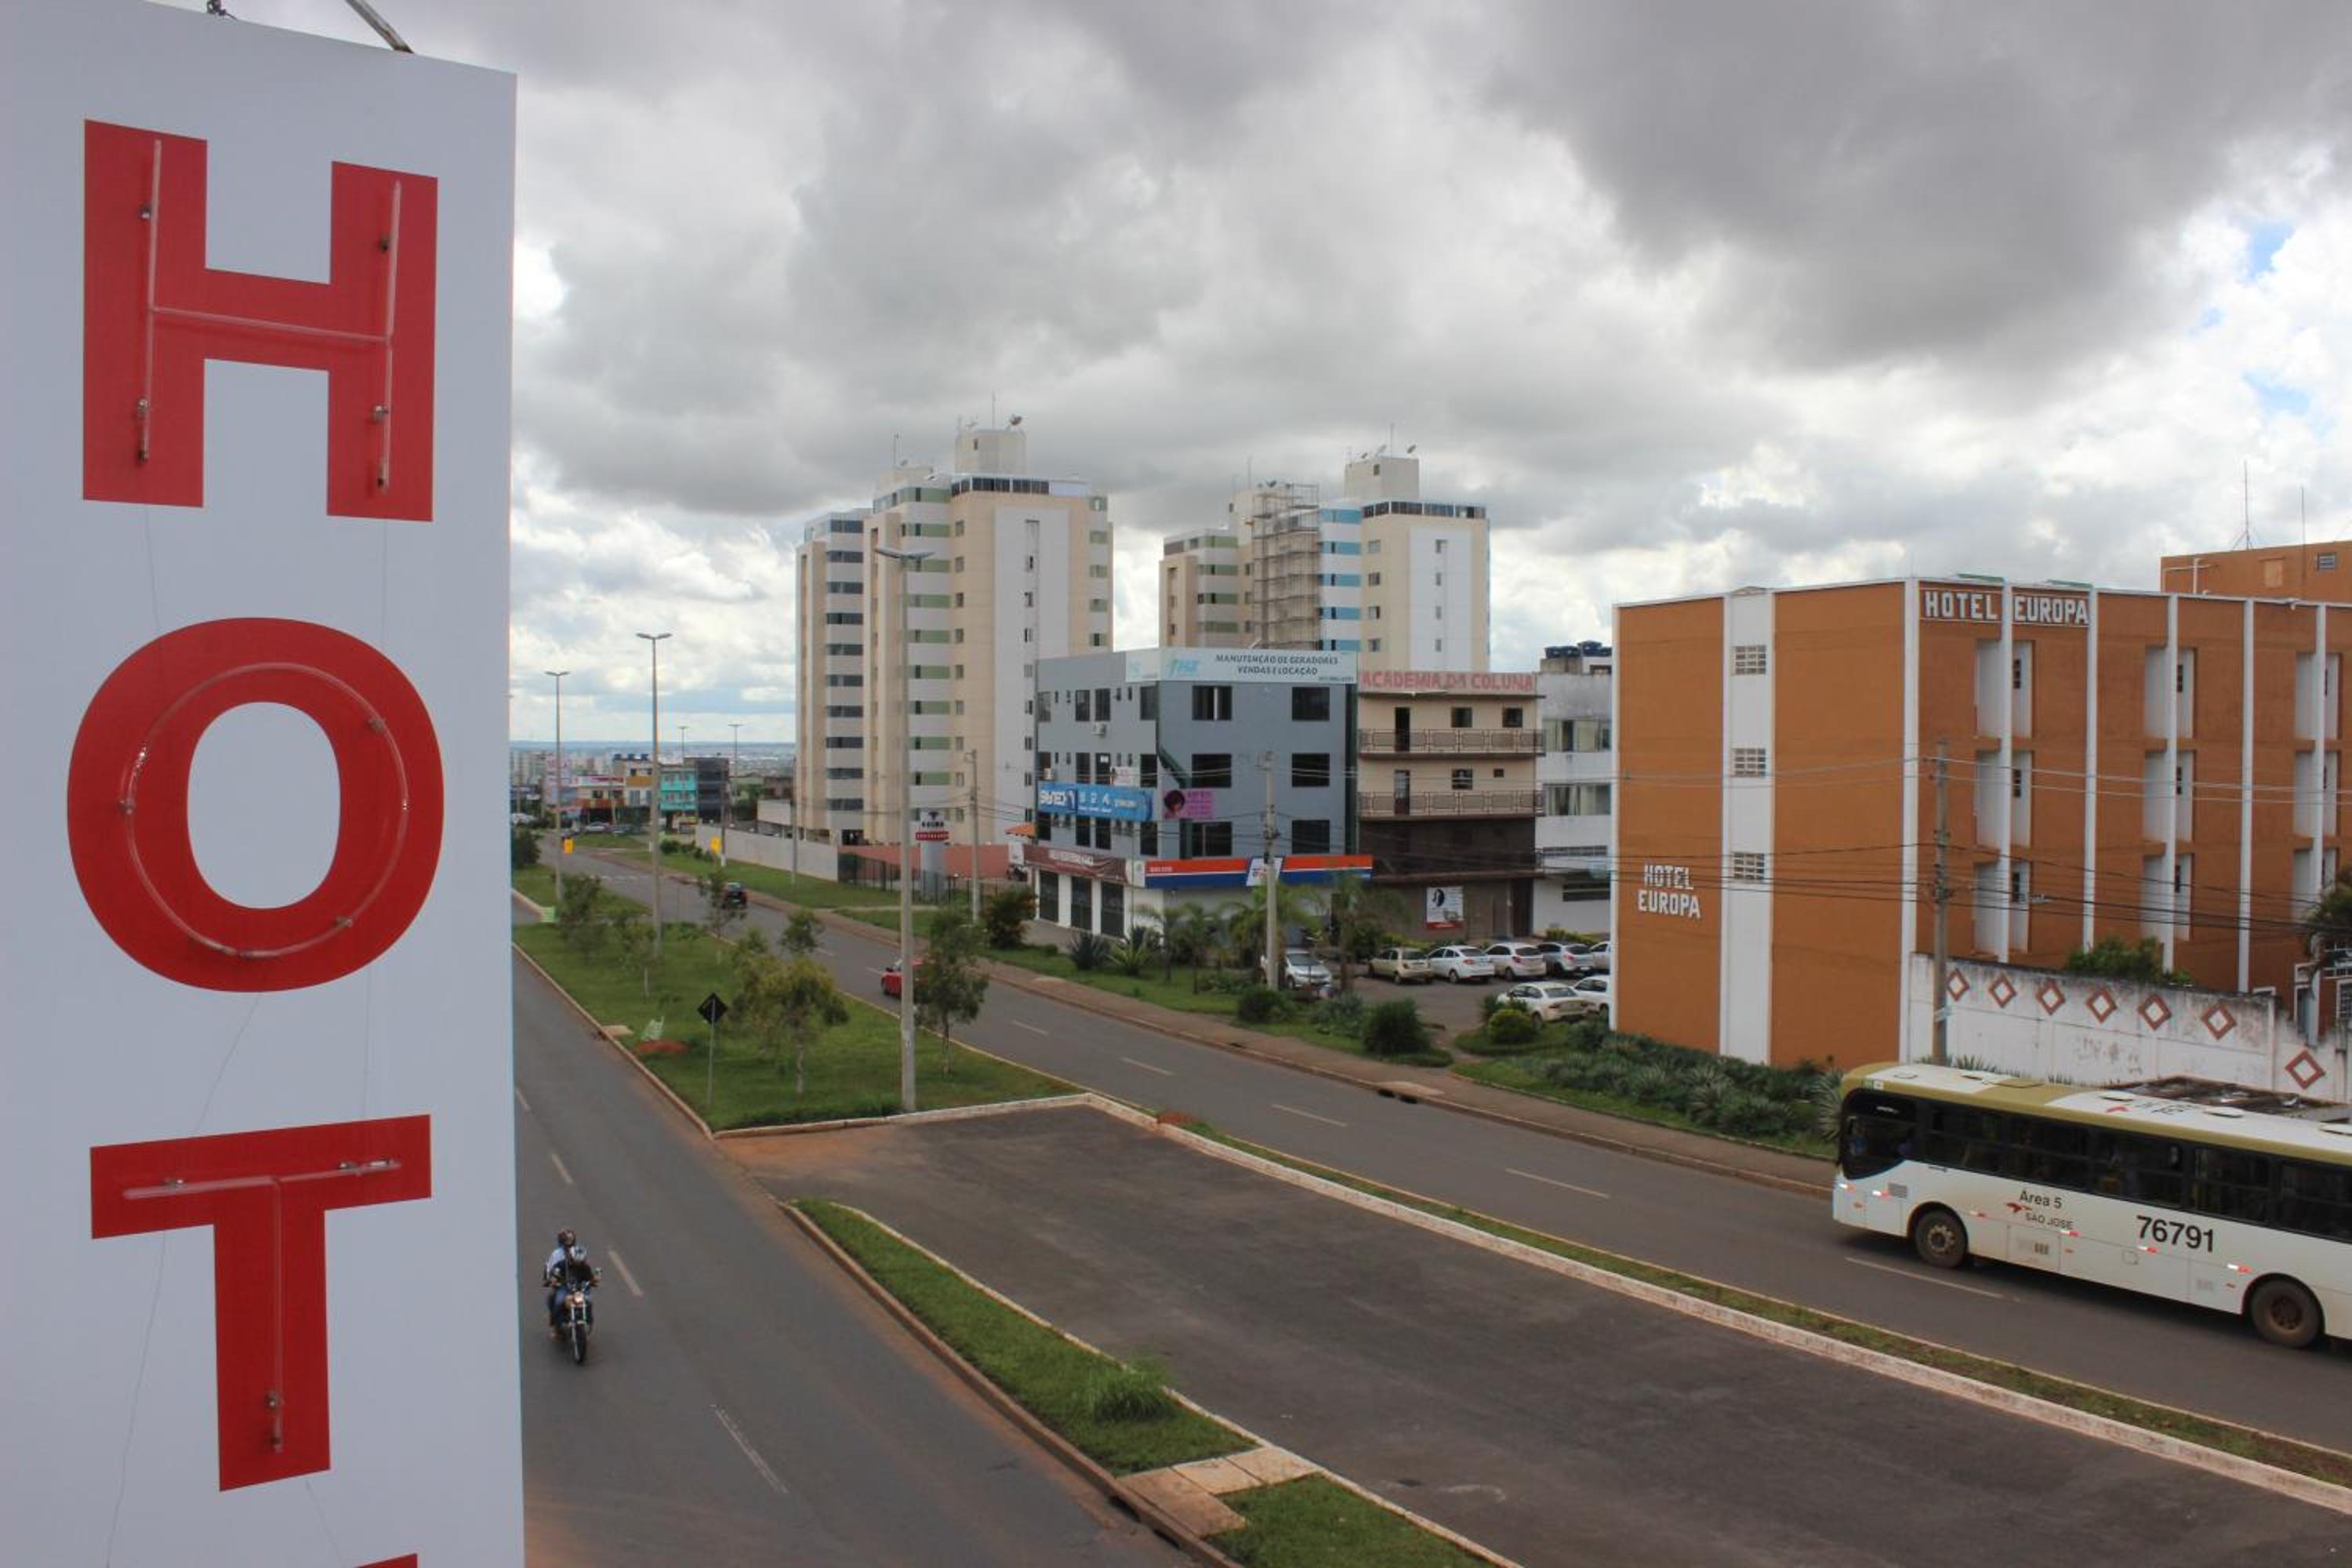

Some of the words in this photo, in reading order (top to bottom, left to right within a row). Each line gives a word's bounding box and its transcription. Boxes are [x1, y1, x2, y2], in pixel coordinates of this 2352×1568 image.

[1925, 591, 1997, 619] HOTEL
[2014, 596, 2089, 623] EUROPA
[1290, 656, 1338, 665] GERADORES
[1360, 671, 1442, 688] ACADEMIA
[1471, 673, 1533, 690] COLUNA
[66, 118, 444, 1568] HOT
[1644, 865, 1693, 890] HOTEL
[1638, 890, 1700, 918] EUROPA
[2053, 1197, 2062, 1209] 5
[2136, 1215, 2213, 1253] 76791
